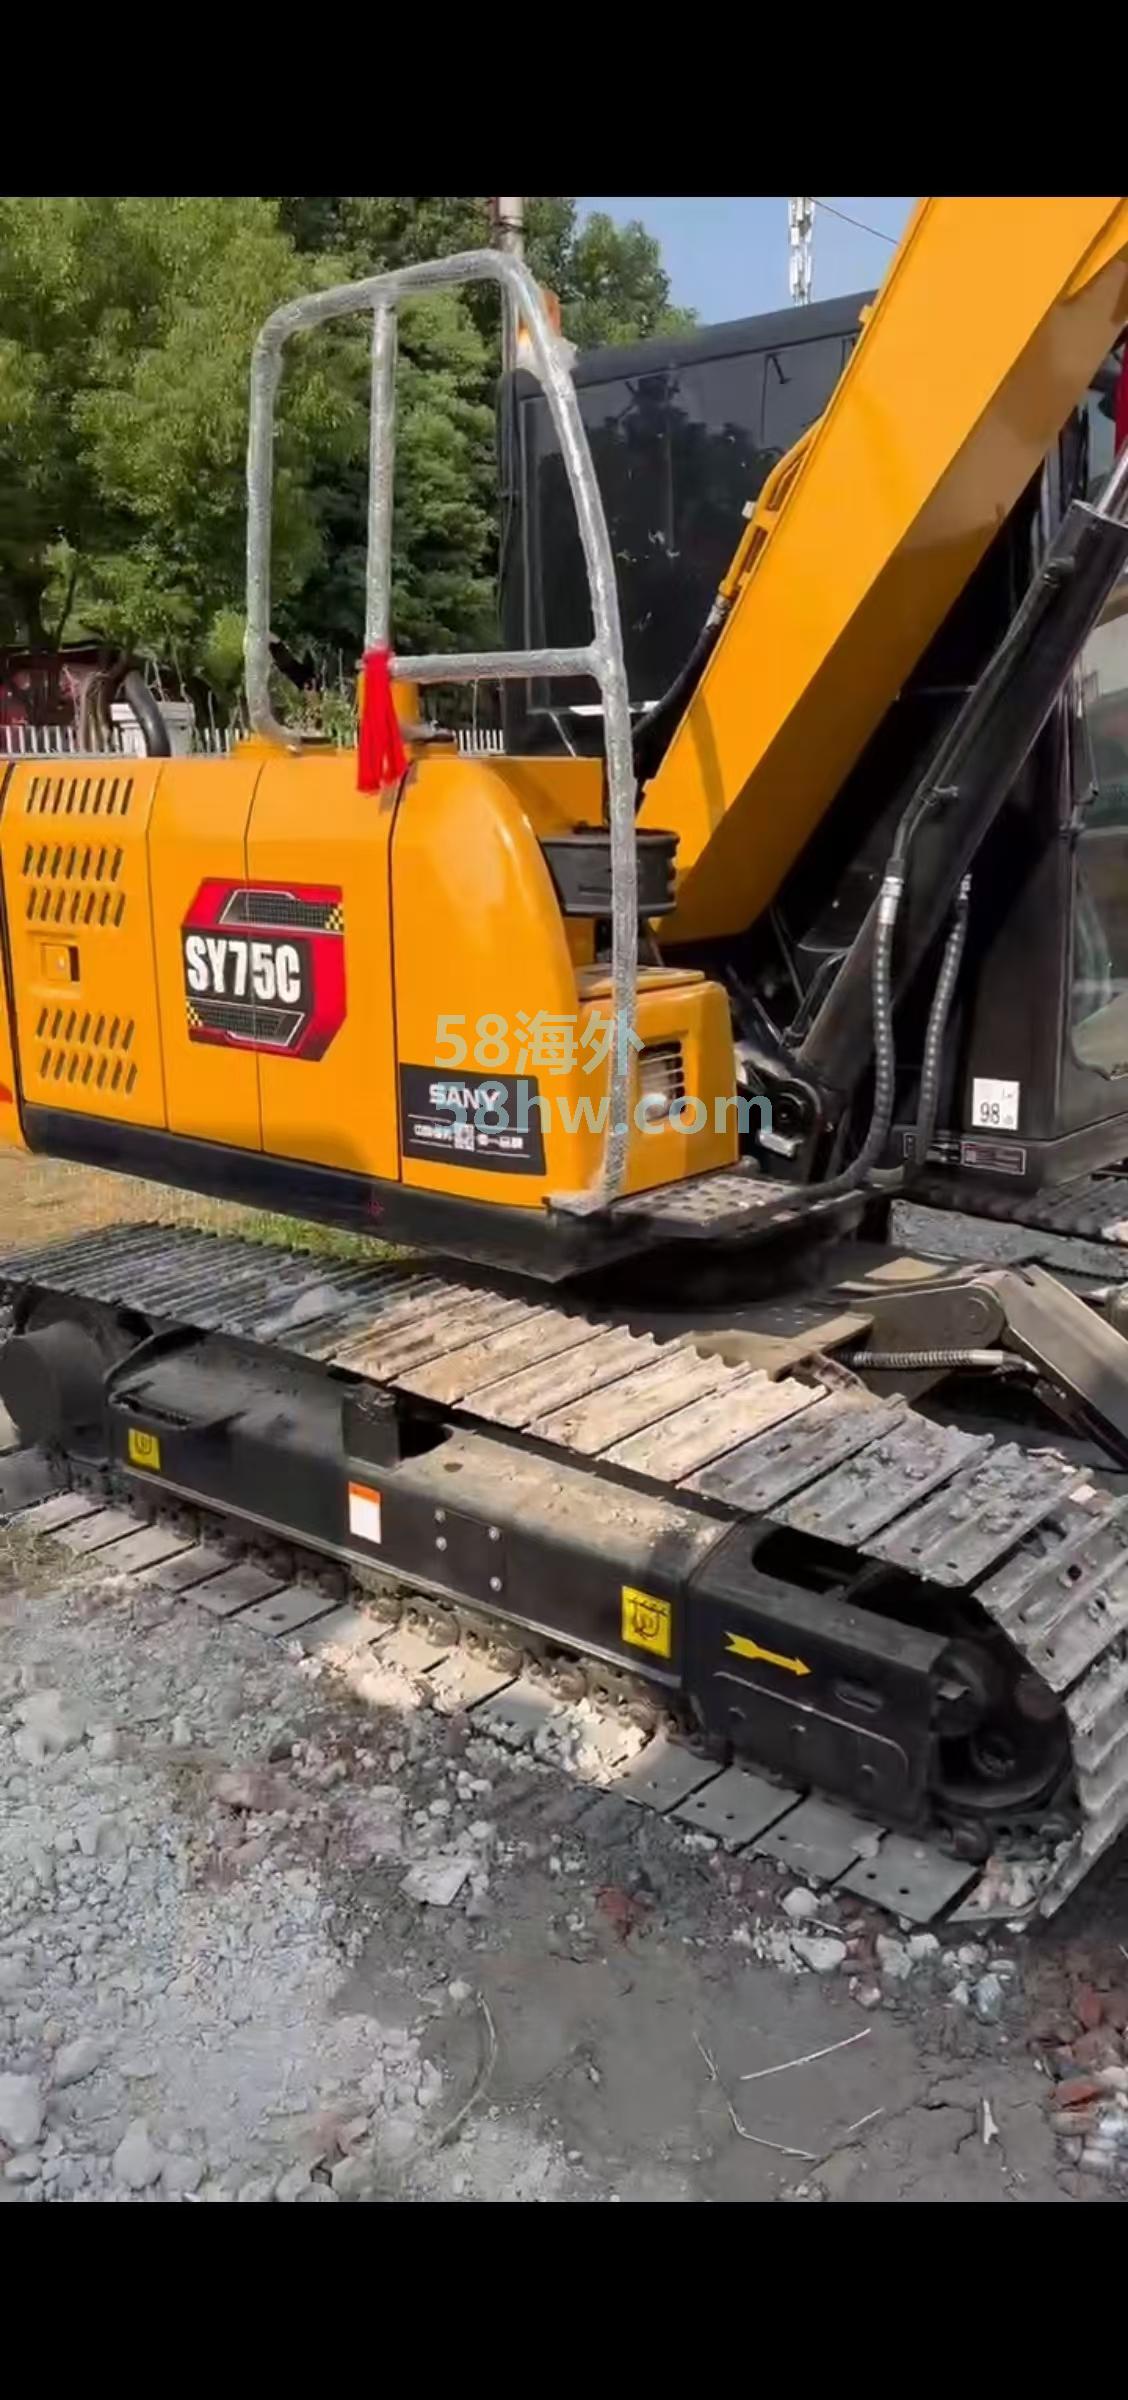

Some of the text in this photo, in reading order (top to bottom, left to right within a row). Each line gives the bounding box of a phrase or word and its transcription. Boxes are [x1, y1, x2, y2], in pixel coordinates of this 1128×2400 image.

[185, 935, 301, 1003] SY75C
[428, 1083, 501, 1111] SANY
[980, 1102, 1000, 1125] 98
